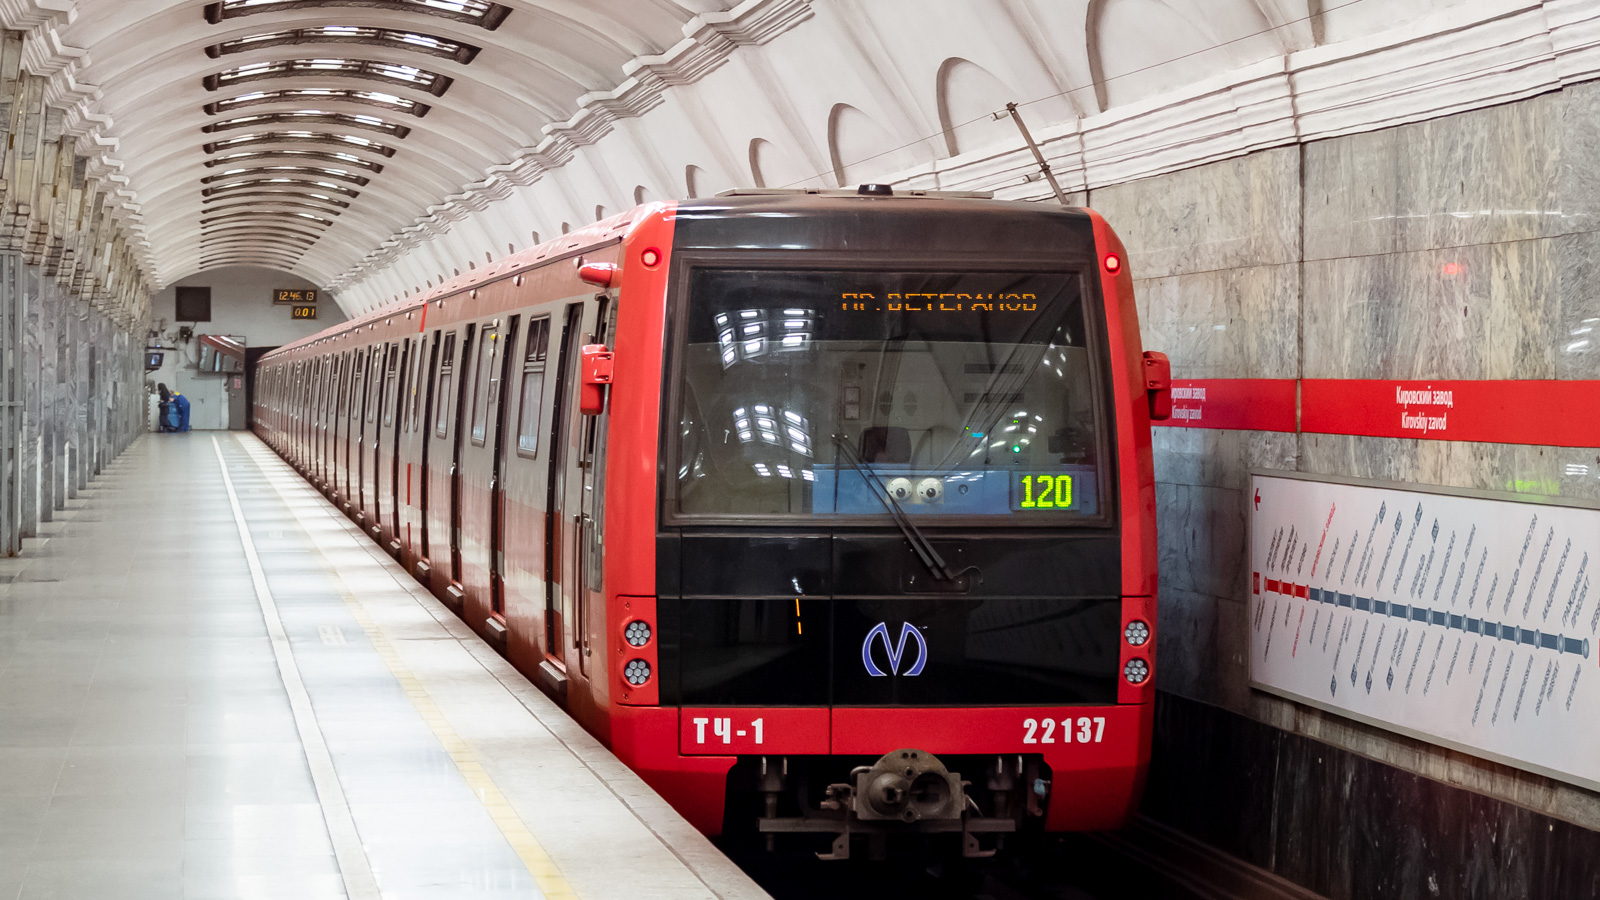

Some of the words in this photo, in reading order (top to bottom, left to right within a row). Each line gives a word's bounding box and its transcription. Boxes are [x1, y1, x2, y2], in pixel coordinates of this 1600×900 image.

[1396, 385, 1432, 409] Кировский
[1432, 390, 1453, 408] завод
[1401, 411, 1428, 434] Kirovskiy
[1428, 411, 1447, 430] zavod
[1021, 475, 1072, 508] 120
[693, 717, 764, 744] ТЧ-1
[1022, 716, 1107, 744] 22137
